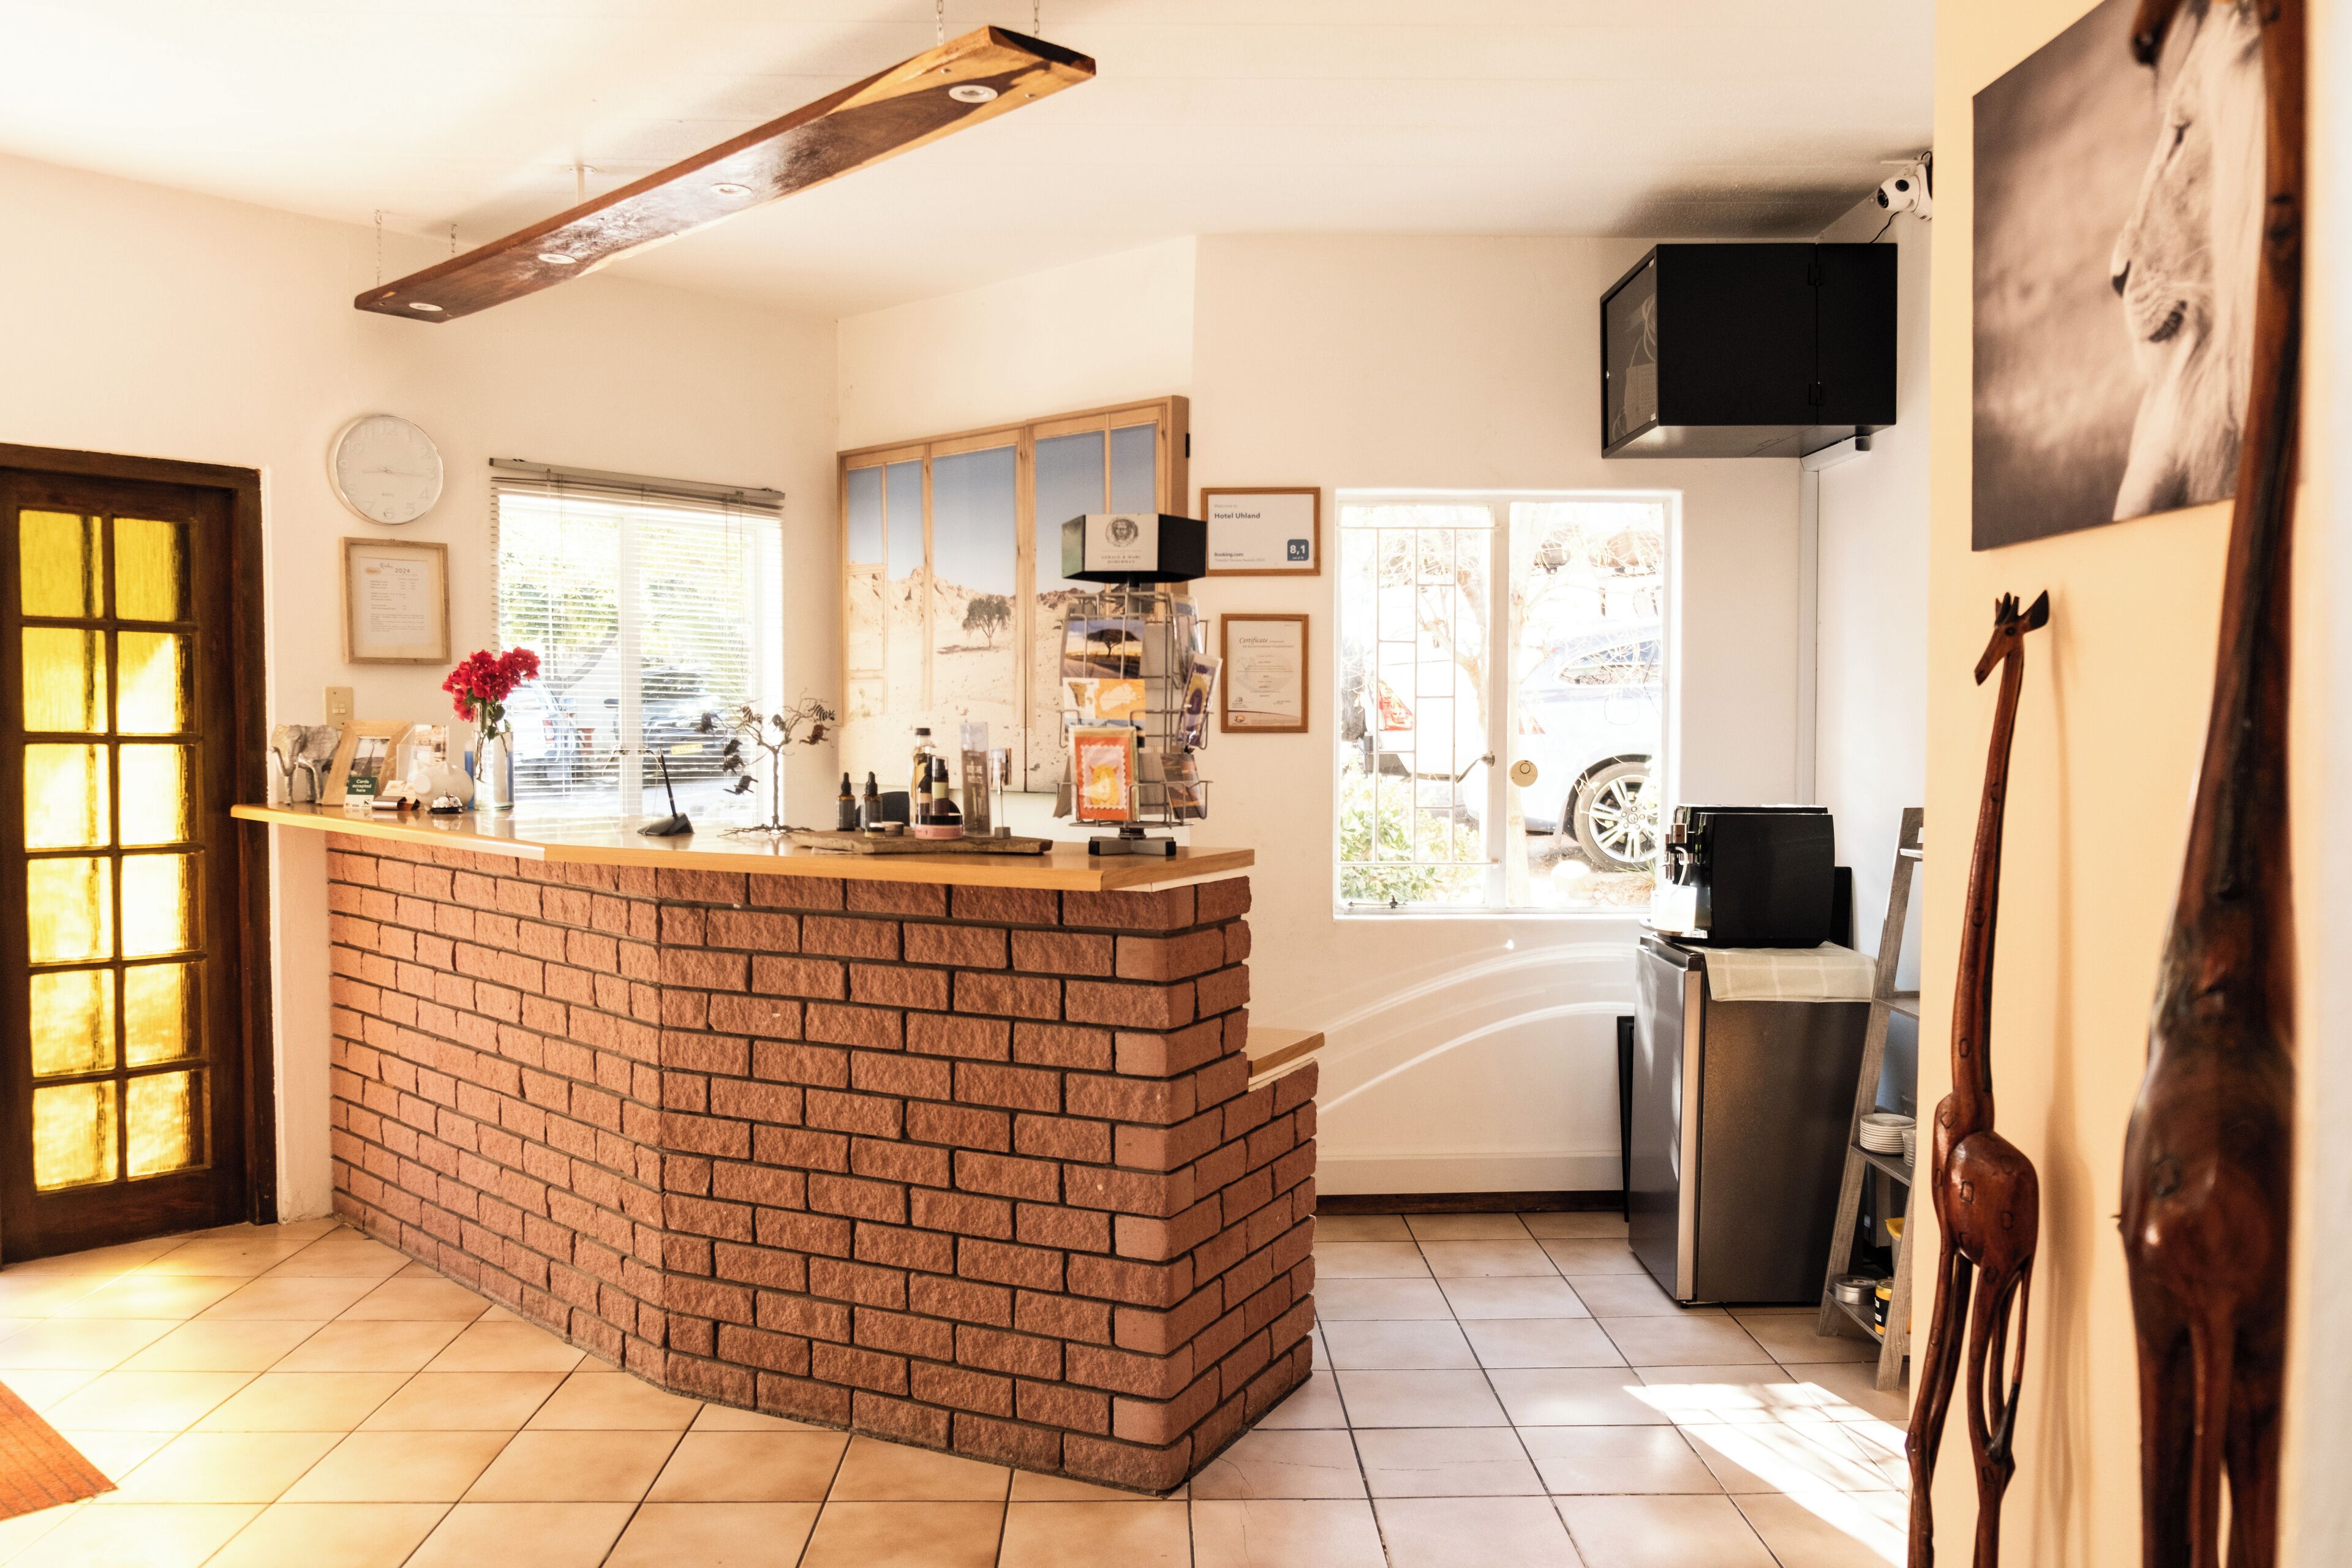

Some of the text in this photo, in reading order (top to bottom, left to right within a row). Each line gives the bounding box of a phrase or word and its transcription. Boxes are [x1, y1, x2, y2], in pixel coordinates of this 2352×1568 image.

[381, 421, 396, 436] 12
[344, 441, 364, 454] 10
[1290, 545, 1305, 555] 8,1
